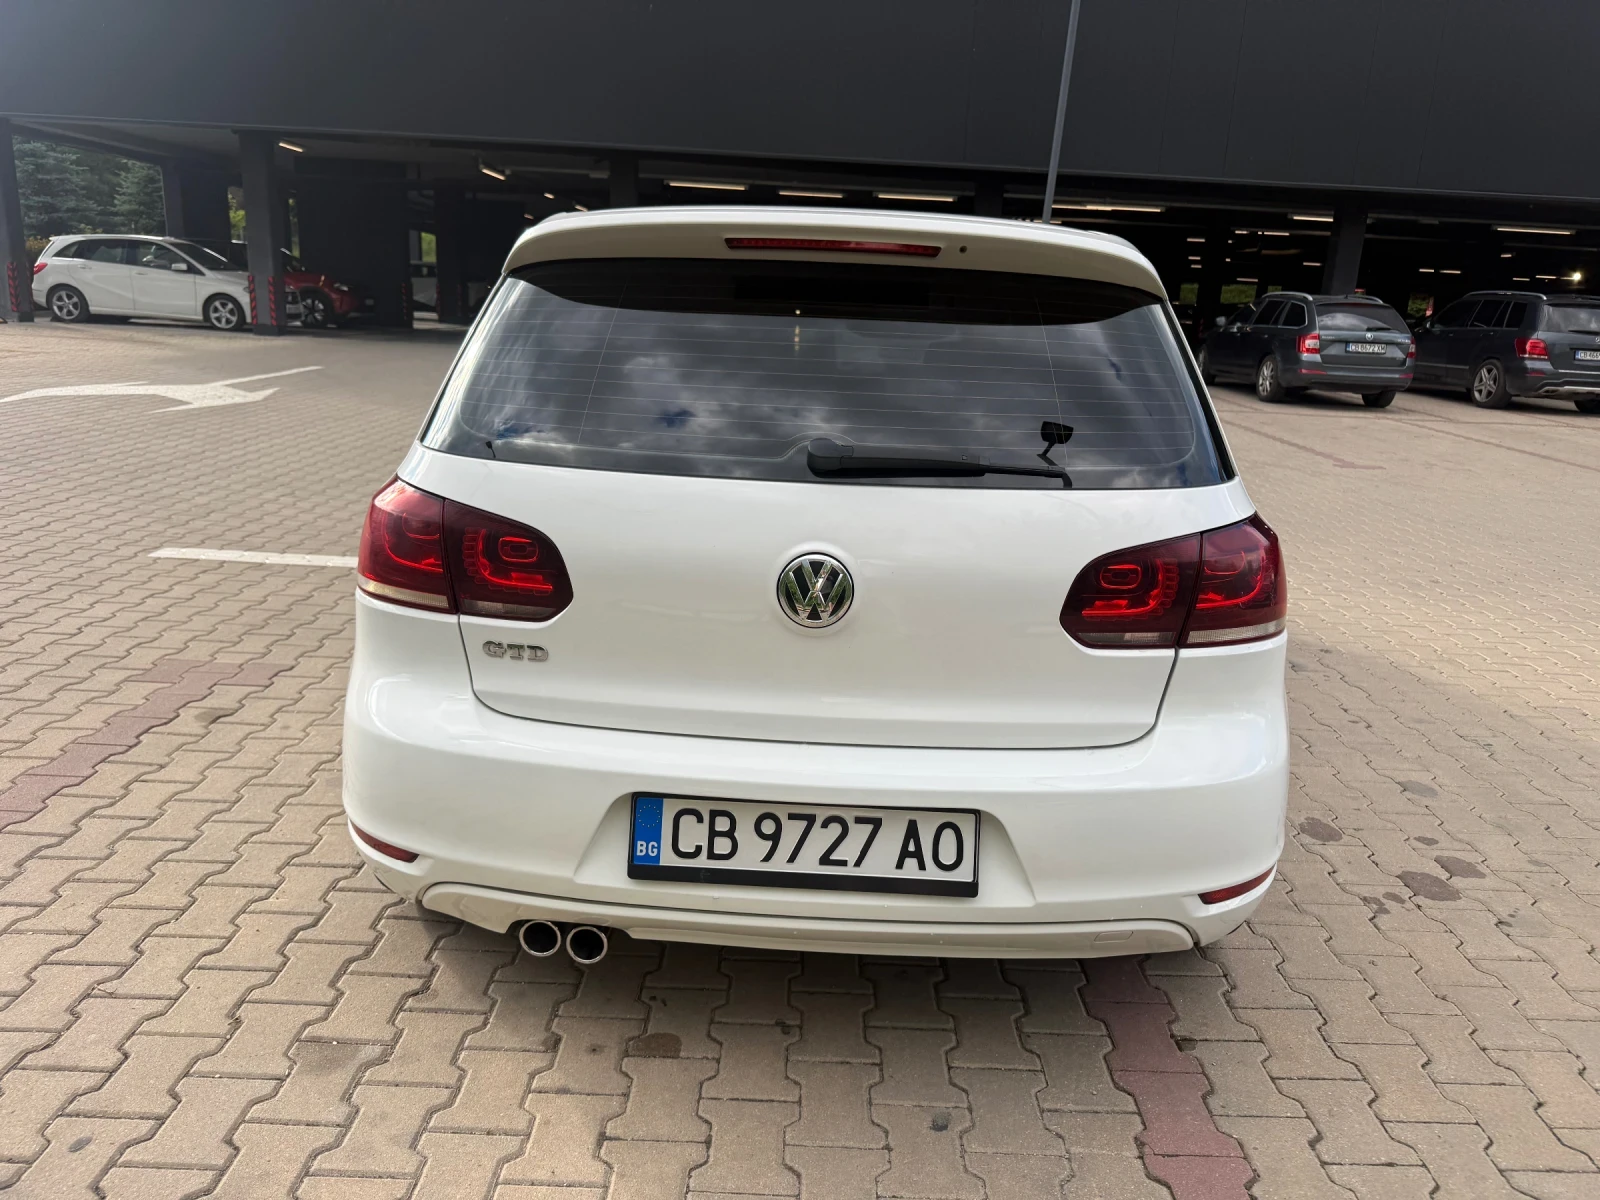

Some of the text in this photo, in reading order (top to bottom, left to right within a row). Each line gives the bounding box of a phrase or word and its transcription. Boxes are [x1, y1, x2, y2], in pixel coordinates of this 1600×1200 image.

[1351, 343, 1360, 352] CB
[1580, 351, 1600, 359] CB 466
[780, 556, 851, 625] VW
[482, 640, 549, 662] GTD
[636, 840, 659, 857] BG
[671, 807, 965, 872] CB 9727 AO
